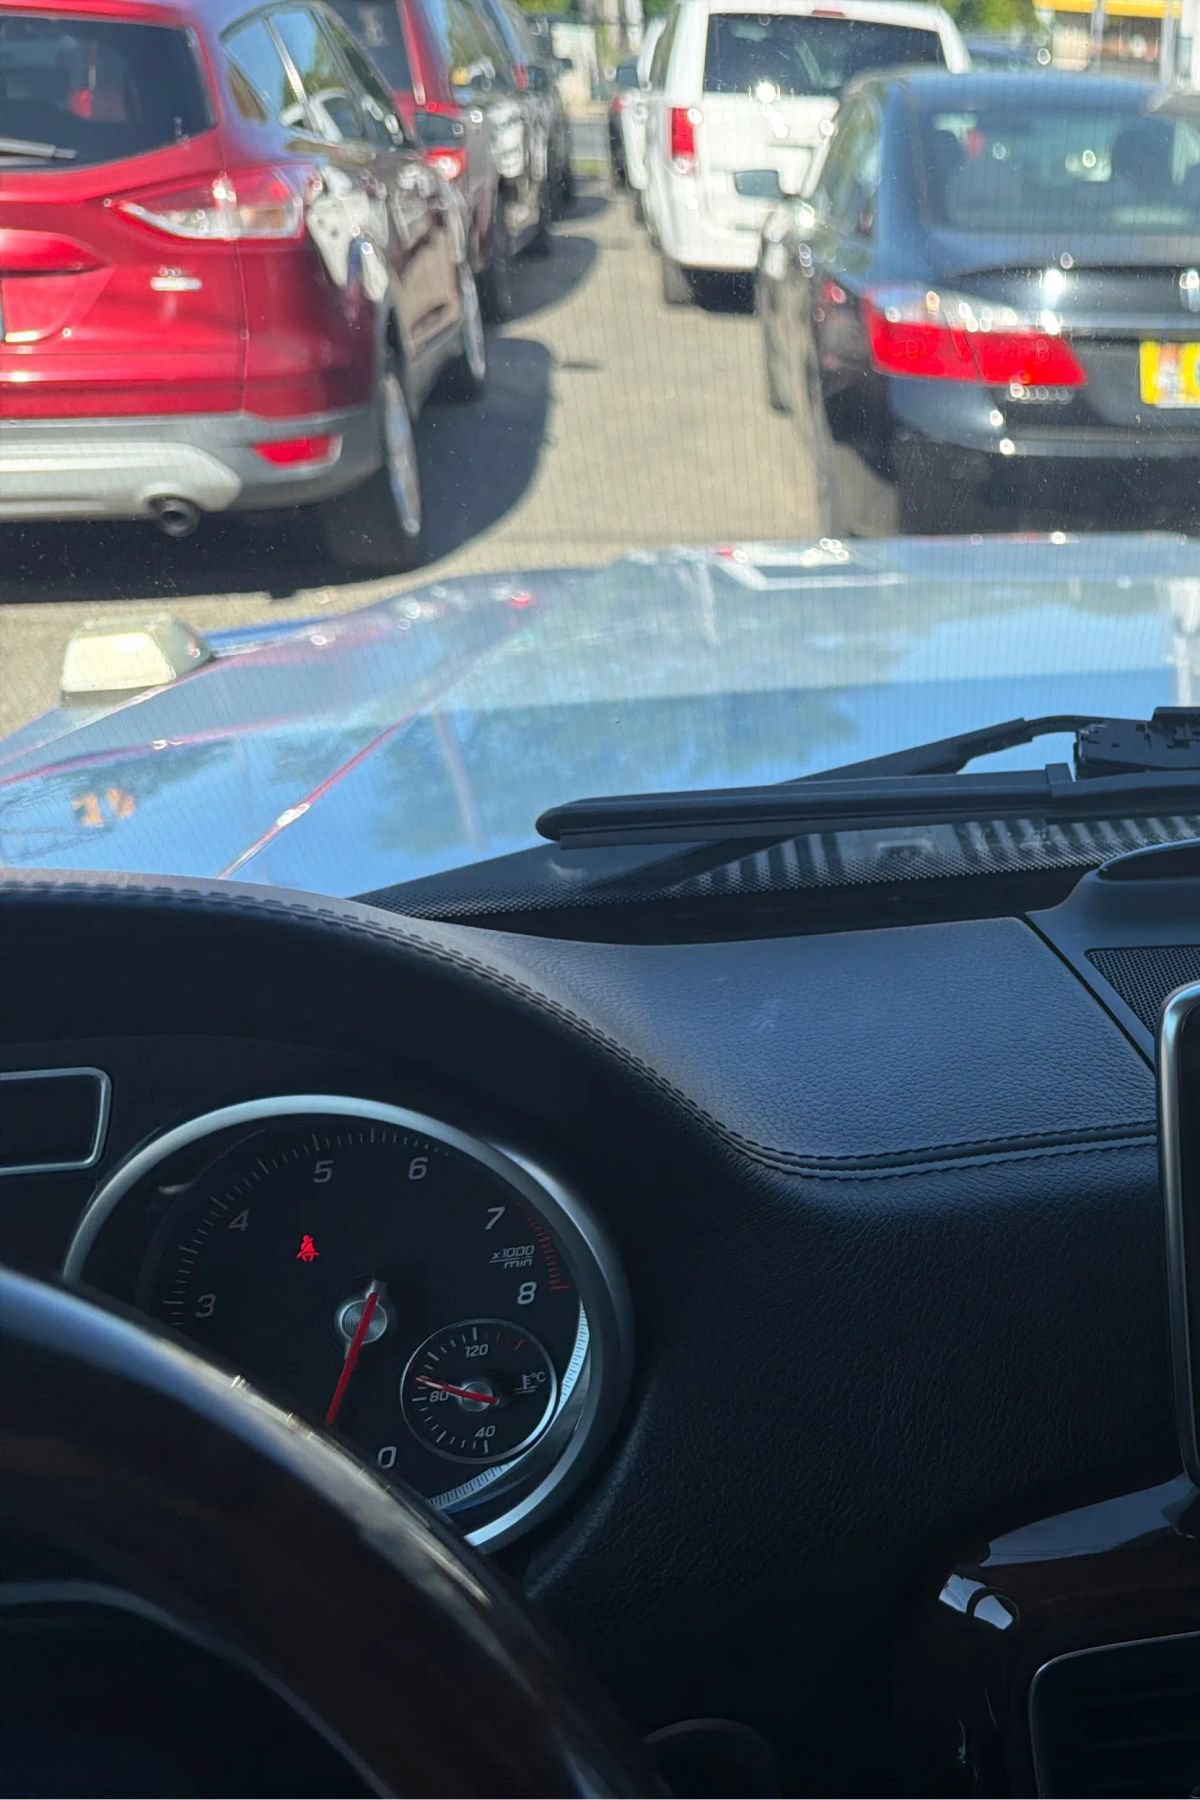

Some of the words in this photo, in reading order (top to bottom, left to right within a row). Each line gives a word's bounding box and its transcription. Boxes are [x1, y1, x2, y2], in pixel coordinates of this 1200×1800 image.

[313, 1160, 334, 1183] 5
[408, 1156, 429, 1180] 6
[228, 1209, 249, 1231] 4
[485, 1206, 505, 1231] 7
[503, 1256, 534, 1269] min
[517, 1281, 537, 1305] 8
[195, 1294, 216, 1318] 3
[465, 1343, 489, 1357] 120
[429, 1390, 450, 1403] 80
[475, 1425, 496, 1439] 40
[378, 1446, 397, 1468] 0
